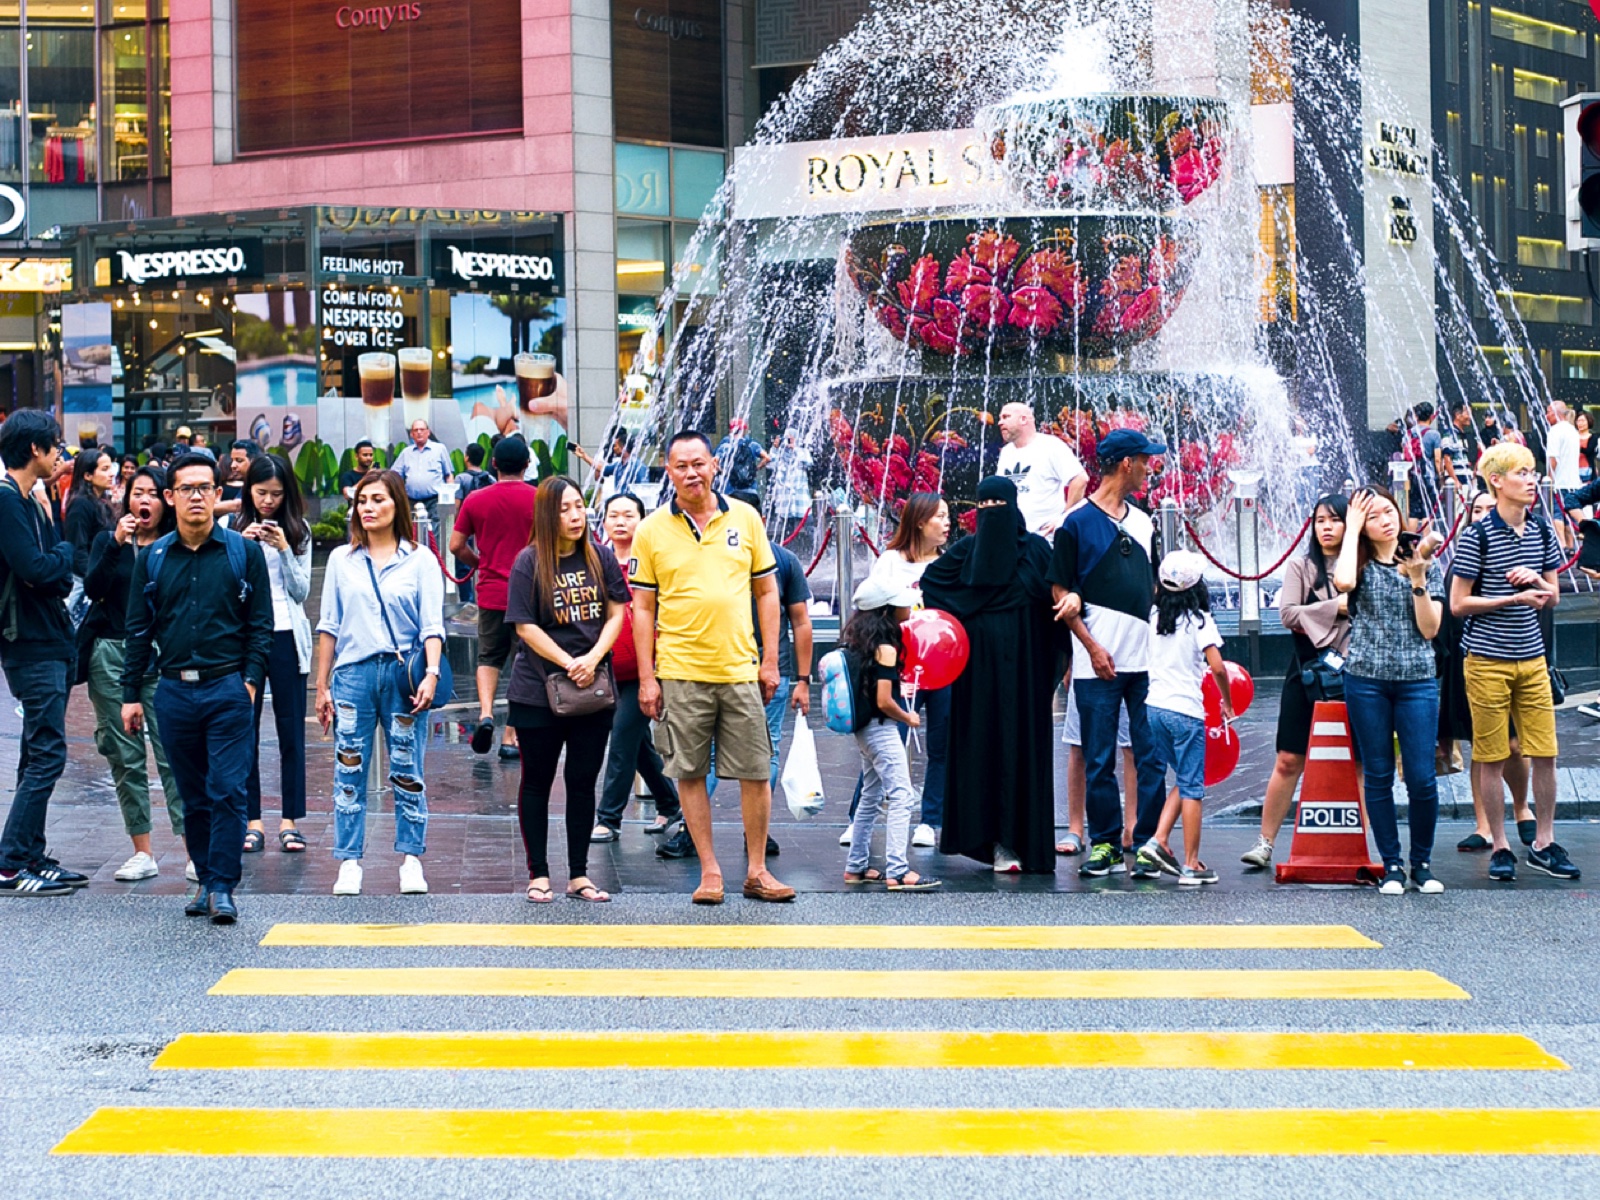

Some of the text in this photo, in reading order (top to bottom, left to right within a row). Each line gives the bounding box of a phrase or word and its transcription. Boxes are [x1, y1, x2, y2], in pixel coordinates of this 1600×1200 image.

[335, 2, 421, 31] Comyns
[634, 7, 703, 41] Comyns
[807, 148, 948, 195] ROYAL
[116, 247, 246, 284] NESPRESSO
[322, 256, 404, 275] FEELING HOT?
[446, 245, 554, 281] NESPRESSO
[322, 289, 404, 308] COME IN FOR A
[322, 308, 404, 329] NESPRESSO
[553, 570, 587, 589] URF
[553, 585, 598, 608] EVERY
[1301, 808, 1359, 826] POLIS
